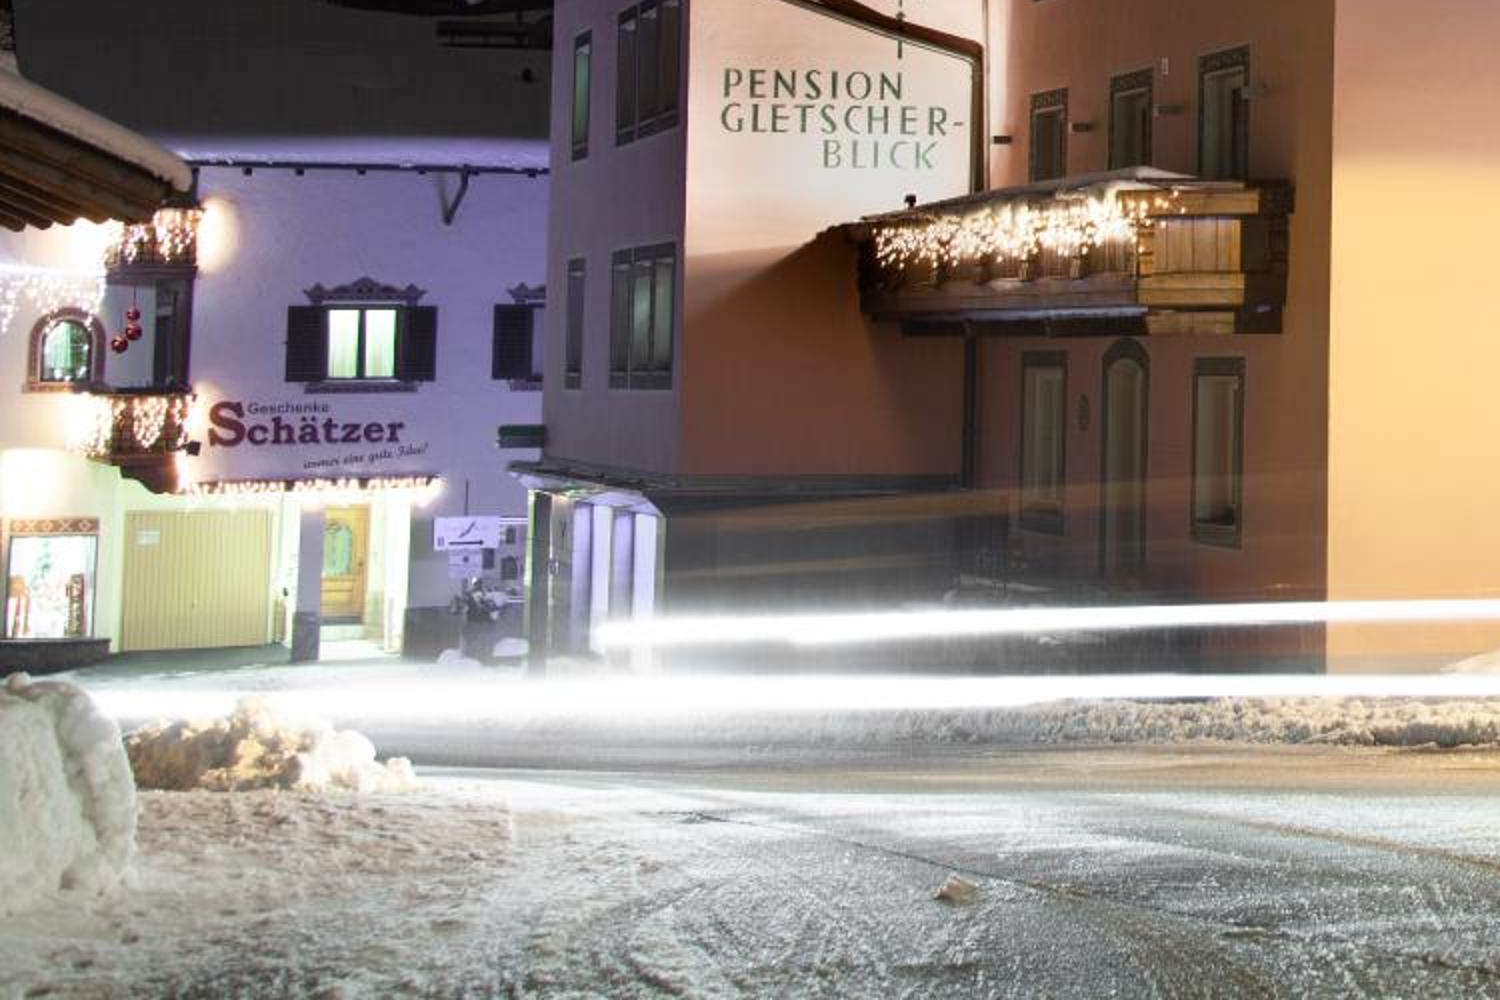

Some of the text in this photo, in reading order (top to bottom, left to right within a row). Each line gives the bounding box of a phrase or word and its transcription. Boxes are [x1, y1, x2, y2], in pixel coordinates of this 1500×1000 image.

[723, 68, 902, 100] PENSION
[720, 103, 964, 136] GLETSCHER-
[822, 139, 938, 169] BLICK
[208, 401, 404, 447] Schätzer
[248, 402, 329, 415] Geschenke
